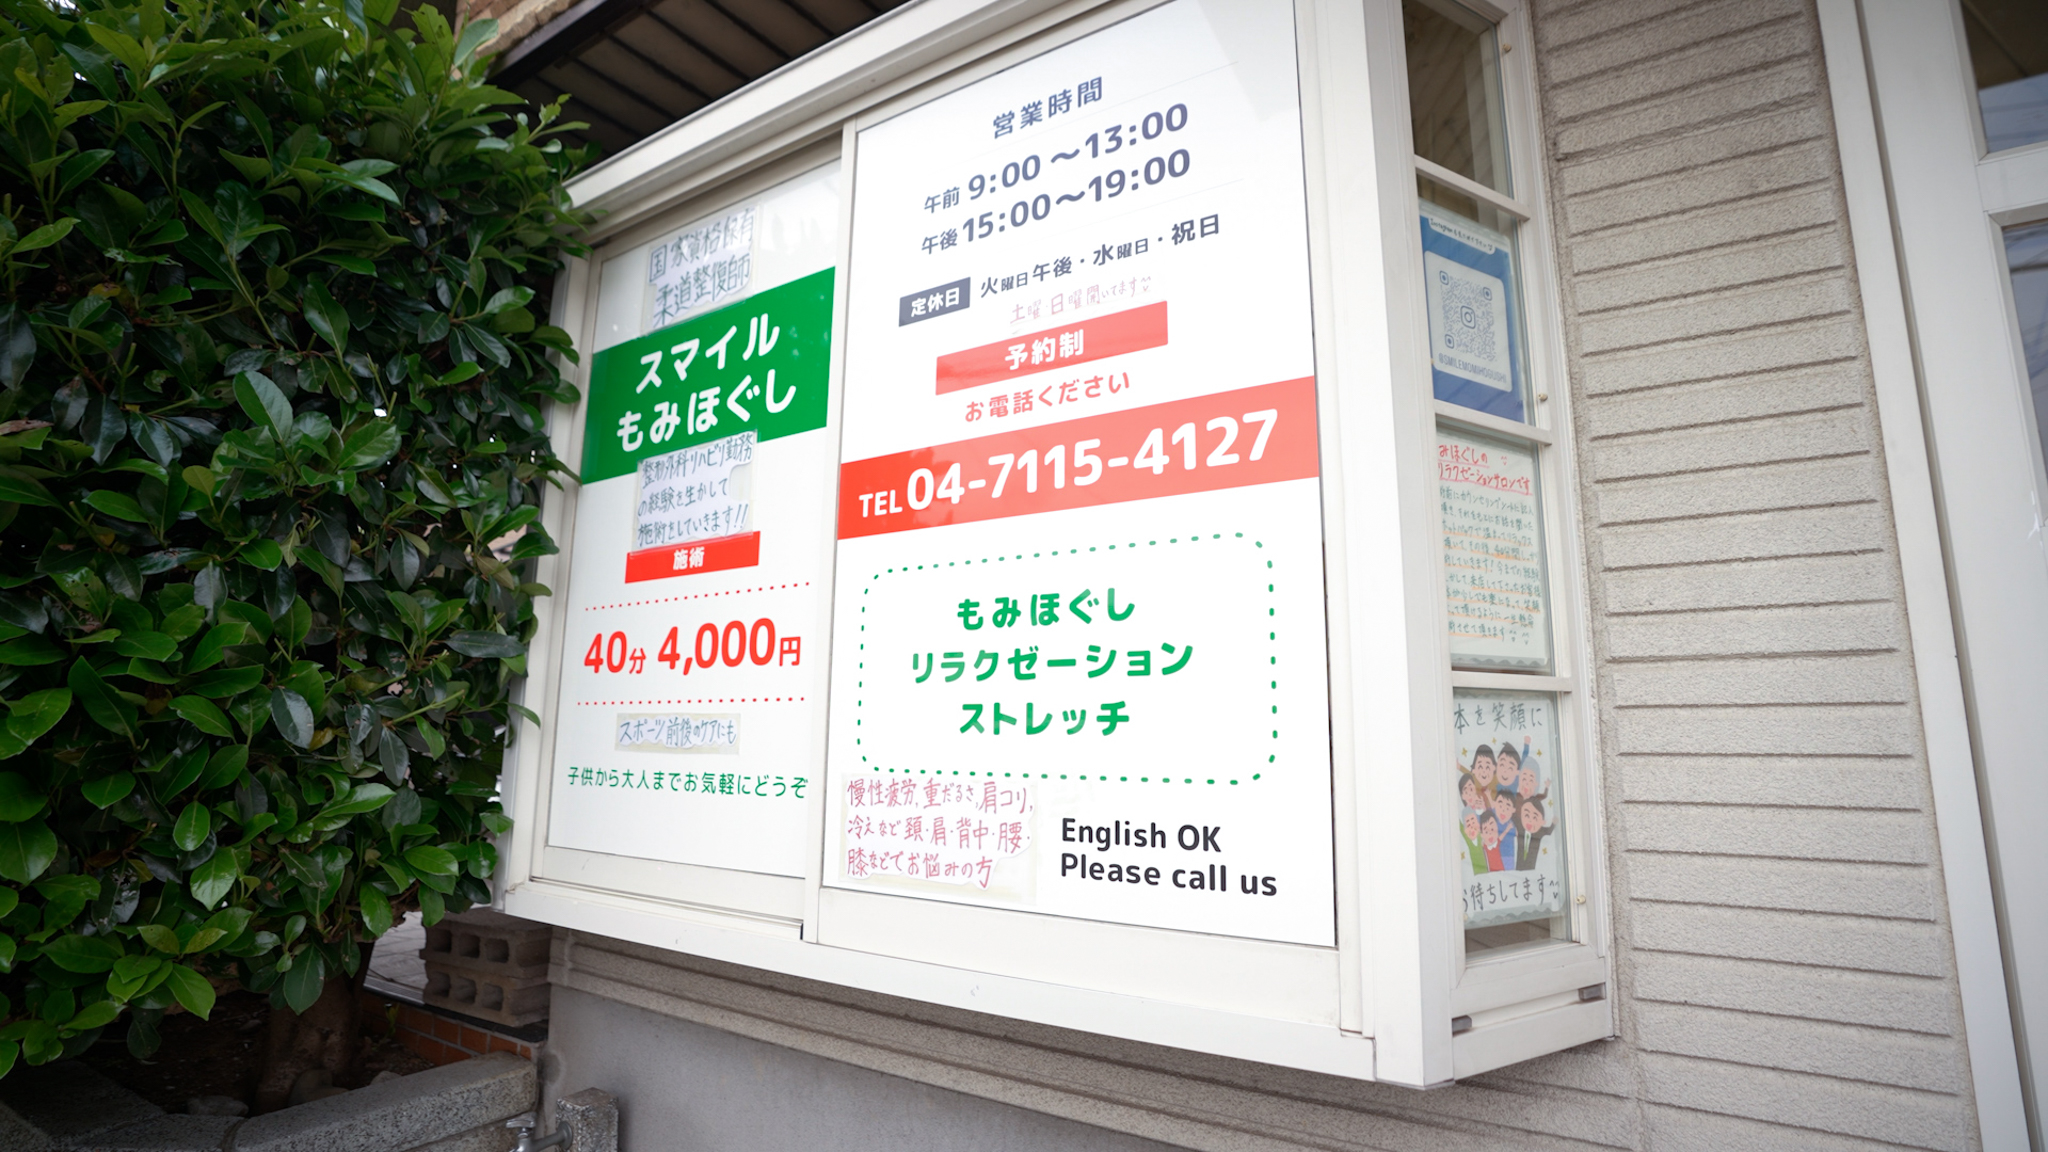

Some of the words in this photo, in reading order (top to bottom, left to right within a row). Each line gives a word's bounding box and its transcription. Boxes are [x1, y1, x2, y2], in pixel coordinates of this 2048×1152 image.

[992, 76, 1103, 139] 営業時間
[923, 186, 960, 214] 午前
[921, 228, 958, 255] 午後
[653, 252, 751, 328] 柔道整復師
[909, 287, 960, 318] 定休日
[636, 313, 780, 394] スマイル
[1004, 329, 1085, 371] 予約制
[616, 369, 797, 452] もみほぐし
[964, 371, 1131, 423] お電話ください
[858, 488, 903, 518] TEL
[906, 408, 1279, 510] 04-7115-4127
[637, 477, 729, 518] の経験を生かして
[672, 547, 705, 570] 施術
[957, 587, 1136, 630] もみほぐし
[584, 631, 647, 675] 40分
[657, 617, 801, 675] 4,000円
[911, 642, 1194, 684] リラクゼーション
[618, 716, 737, 747] スポーツ前後のケアにも
[959, 700, 1131, 737] ストレッチ
[1454, 702, 1543, 734] 本を笑顔に
[567, 766, 809, 798] 子供から大人までお気軽にどうぞ
[1062, 817, 1168, 851] English
[1177, 823, 1222, 853] OK
[1061, 853, 1162, 886] Please
[1171, 863, 1228, 893] call
[1240, 872, 1278, 897] us
